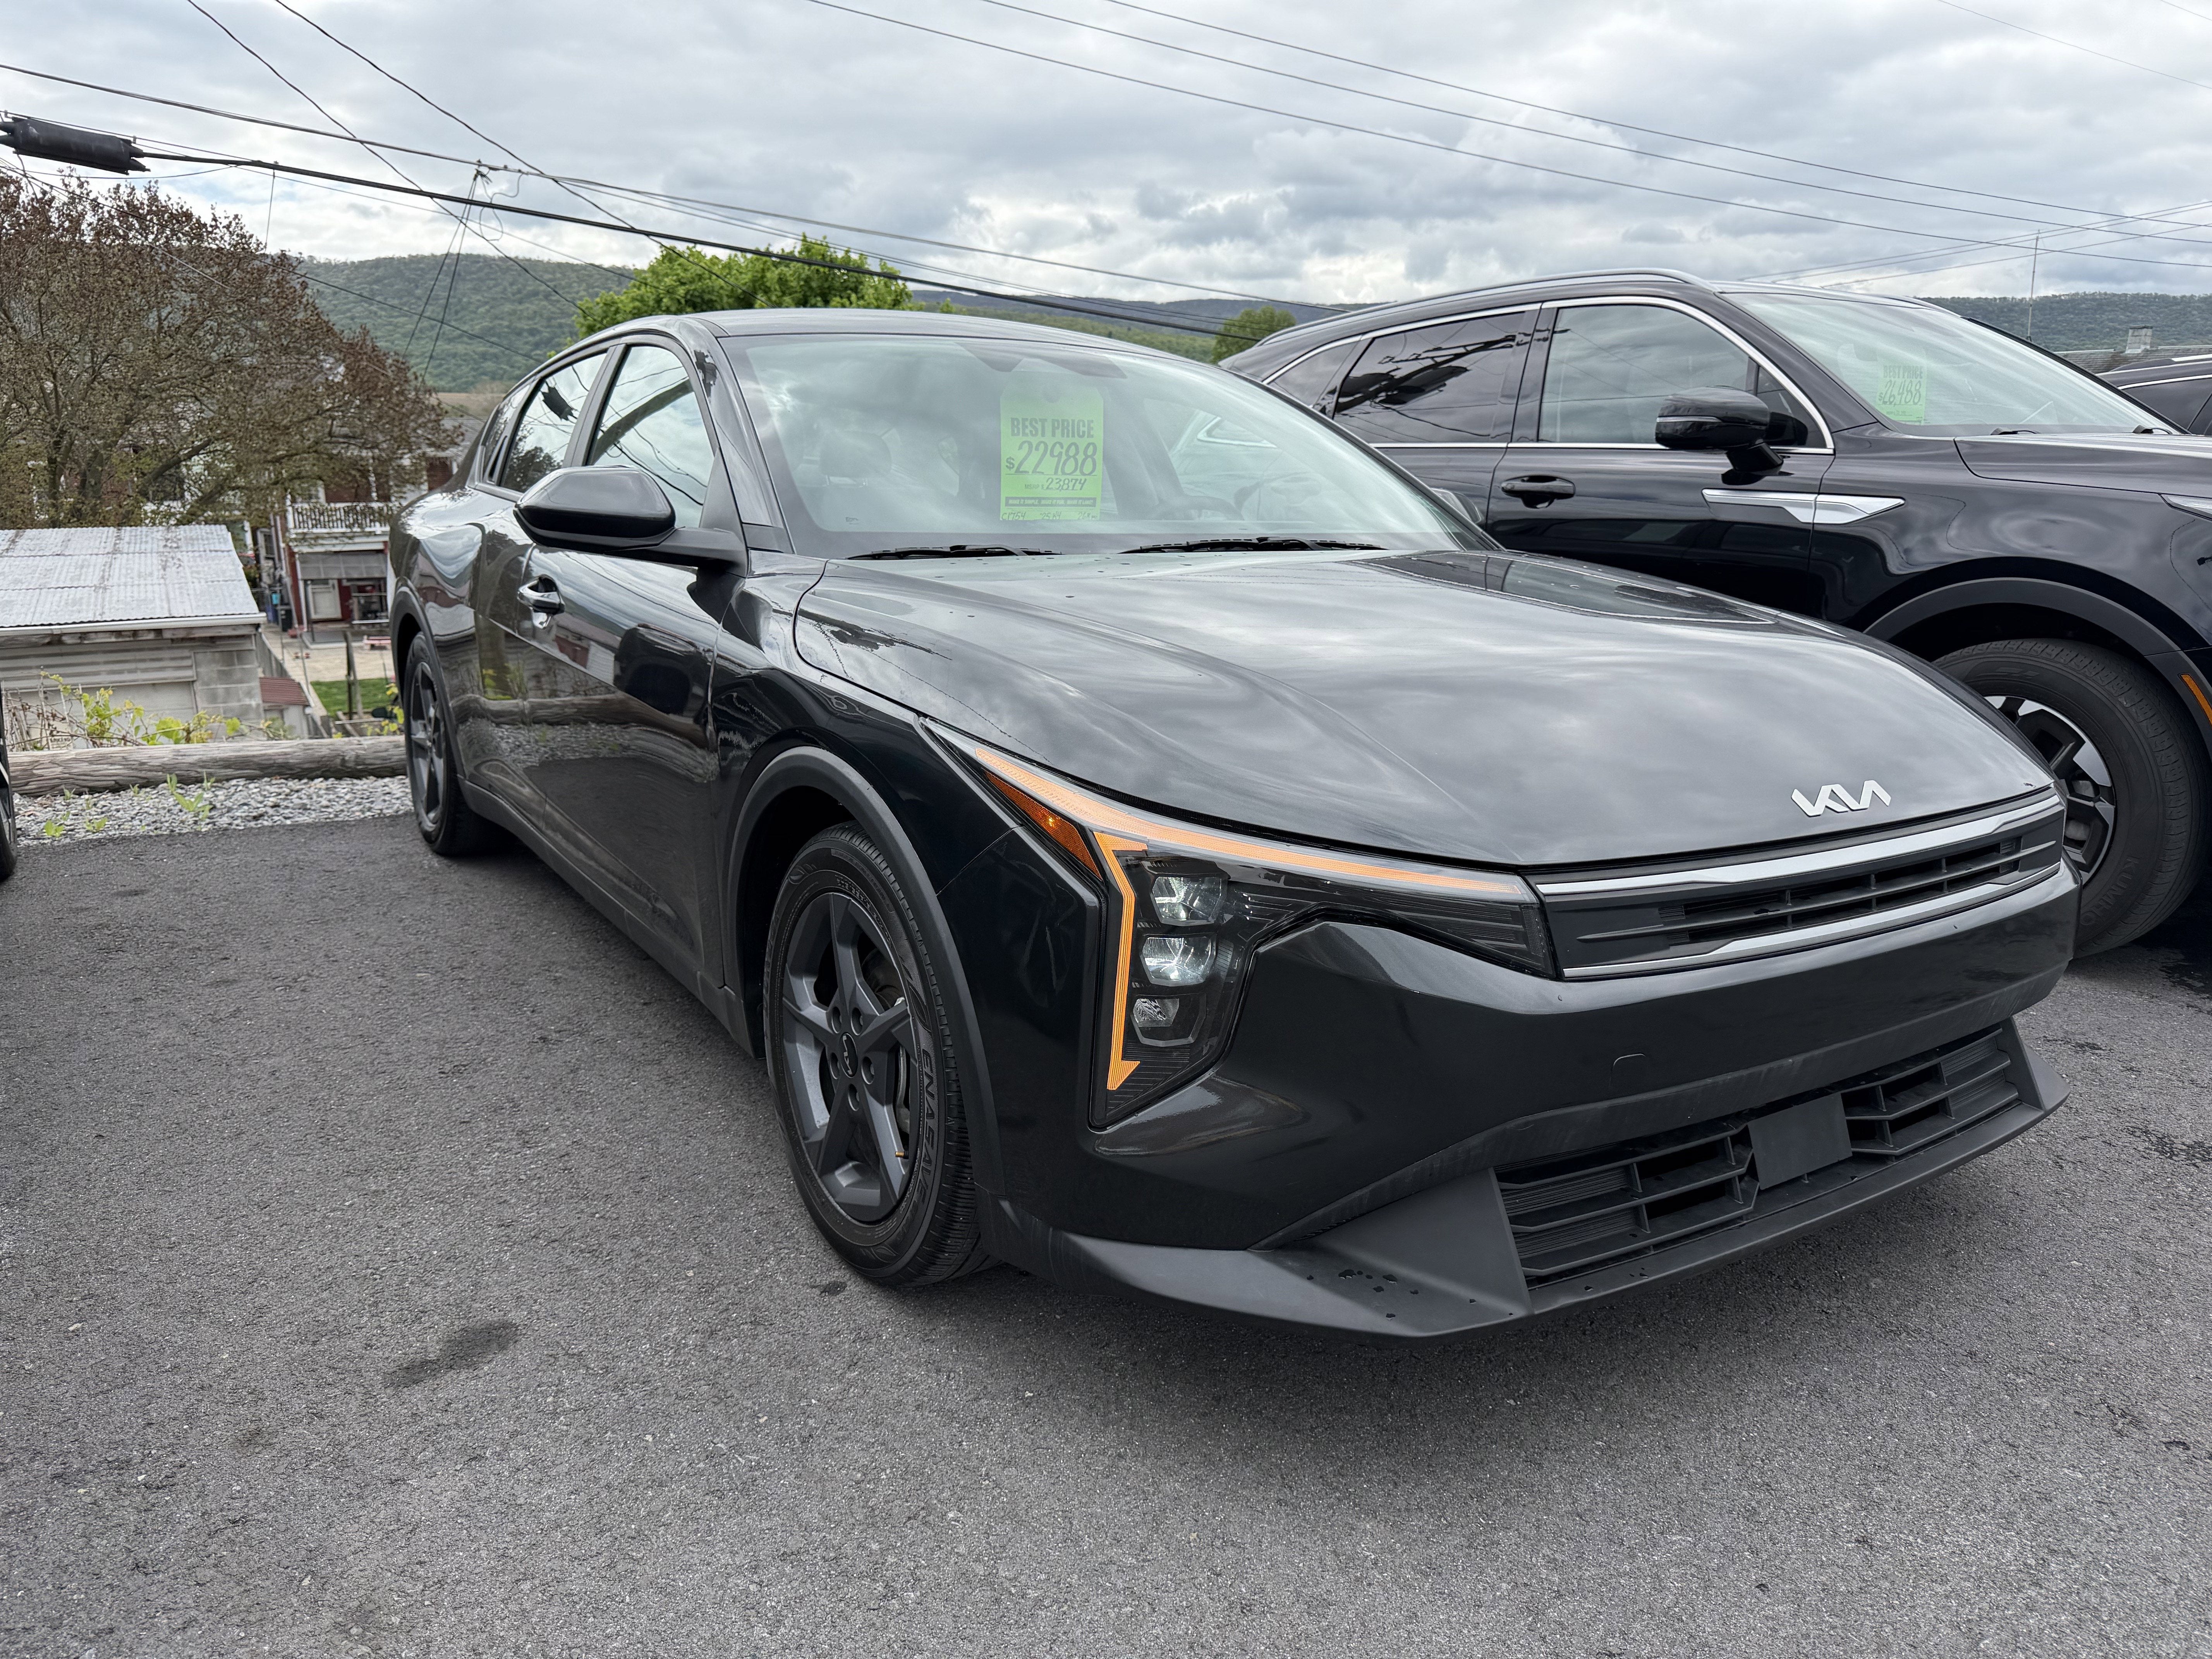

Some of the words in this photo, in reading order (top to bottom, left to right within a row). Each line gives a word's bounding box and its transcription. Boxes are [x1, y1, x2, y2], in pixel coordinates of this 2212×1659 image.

[1884, 365, 1901, 378] BEST
[1902, 366, 1923, 379] PRICE
[1010, 417, 1048, 437] BEST
[1051, 418, 1094, 438] PRICE
[1791, 780, 1891, 817] KIA
[2080, 854, 2142, 926] KUMHO
[917, 1048, 935, 1204] ENASAVE
